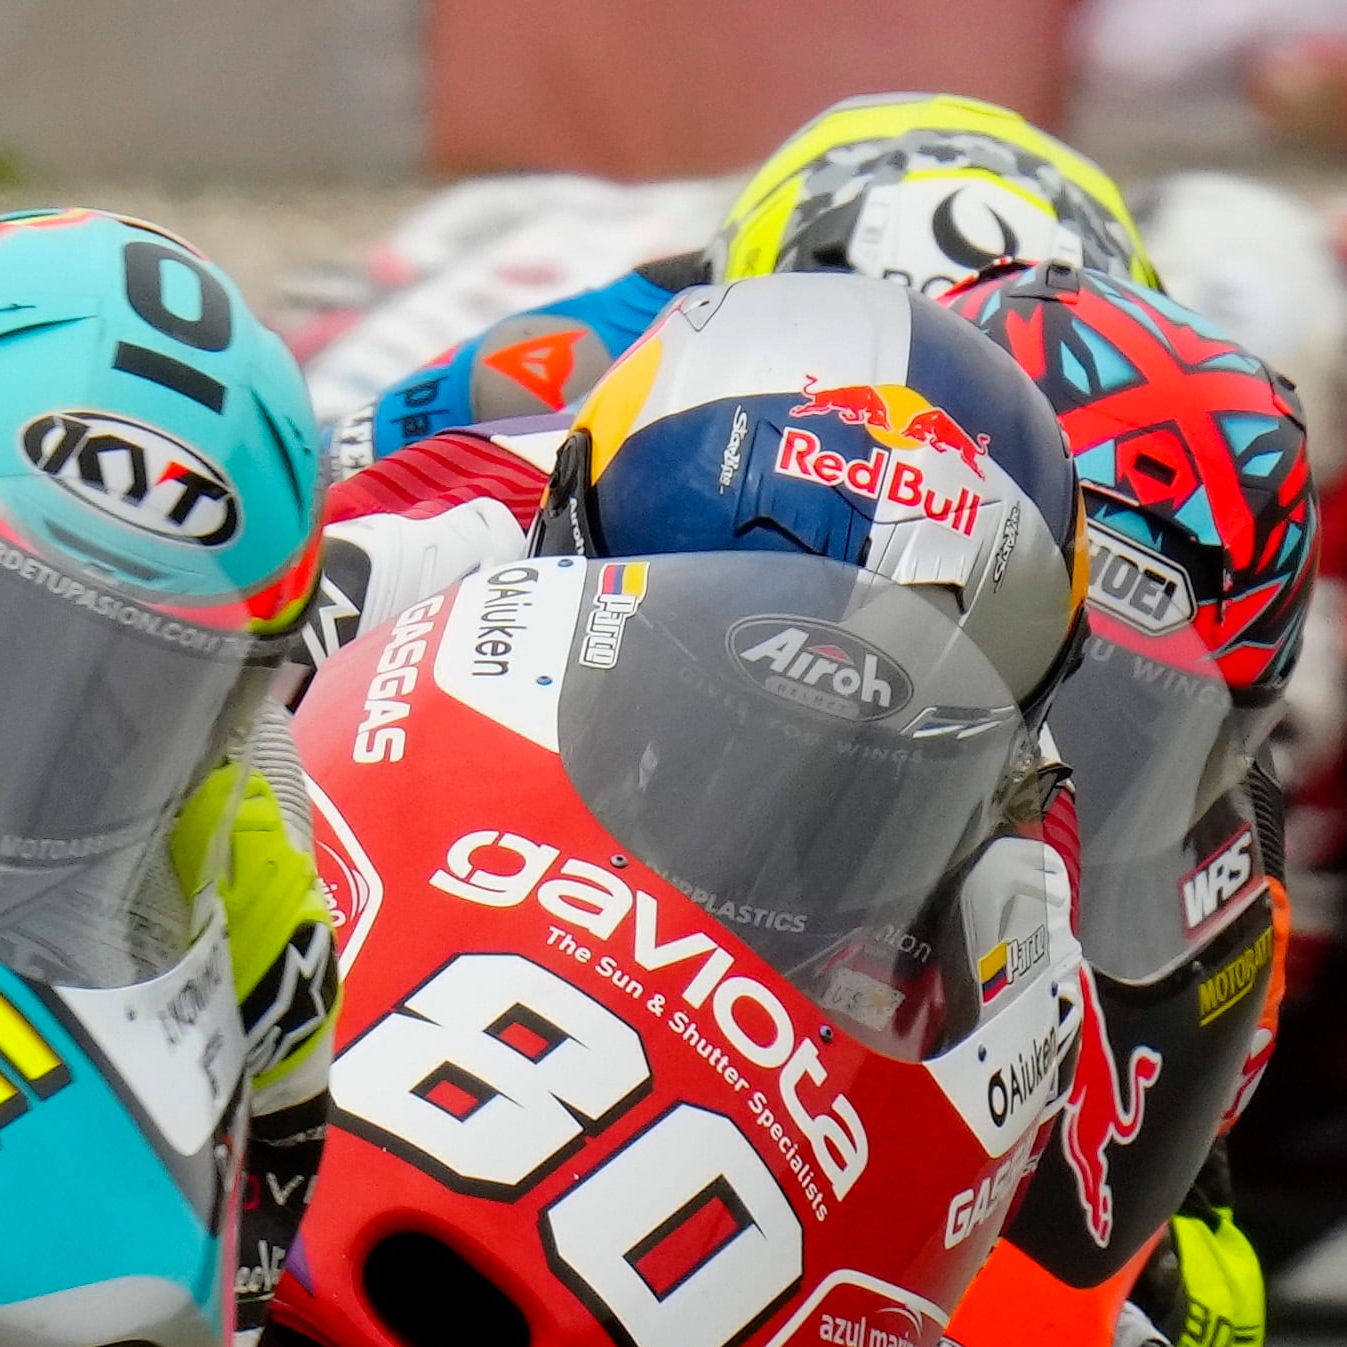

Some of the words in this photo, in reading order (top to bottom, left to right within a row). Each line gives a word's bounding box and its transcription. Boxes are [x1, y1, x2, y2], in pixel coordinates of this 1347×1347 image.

[78, 432, 233, 528] KYT
[776, 428, 890, 500] Red
[886, 459, 982, 538] Bull
[352, 593, 445, 764] GASGAS
[471, 587, 534, 677] Aiuken
[739, 627, 892, 708] Airoh
[1183, 832, 1253, 930] WRS
[428, 829, 868, 1200] gaviota
[546, 925, 595, 968] The
[591, 956, 647, 1002] Sun
[644, 993, 670, 1020] &
[666, 1009, 753, 1095] Shutter
[746, 1091, 829, 1223] Specialists
